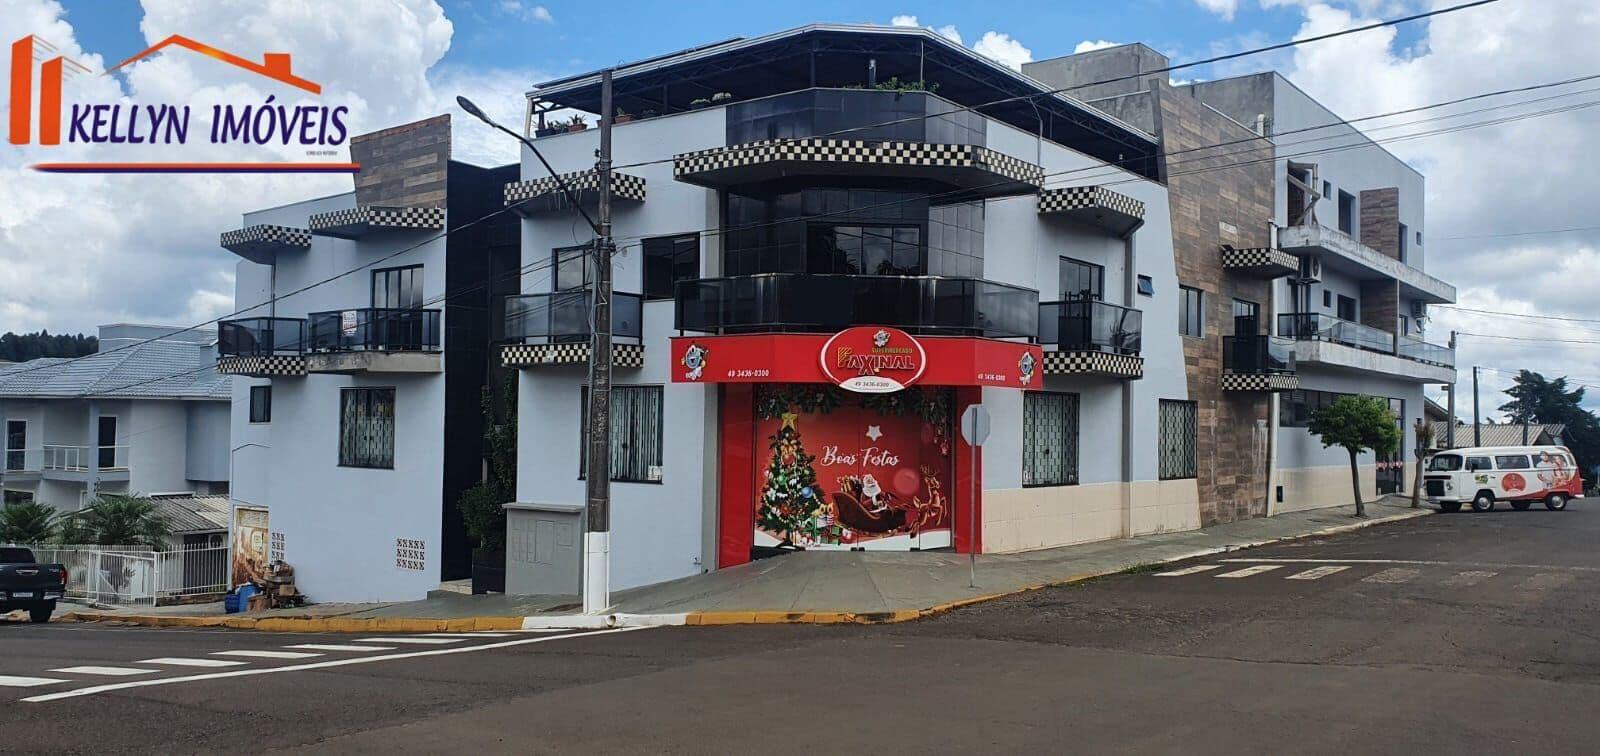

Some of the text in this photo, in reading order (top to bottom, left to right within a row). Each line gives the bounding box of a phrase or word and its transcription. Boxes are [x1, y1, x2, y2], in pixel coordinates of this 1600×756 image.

[837, 346, 915, 376] FAXINAL
[820, 445, 900, 467] Boas Festas
